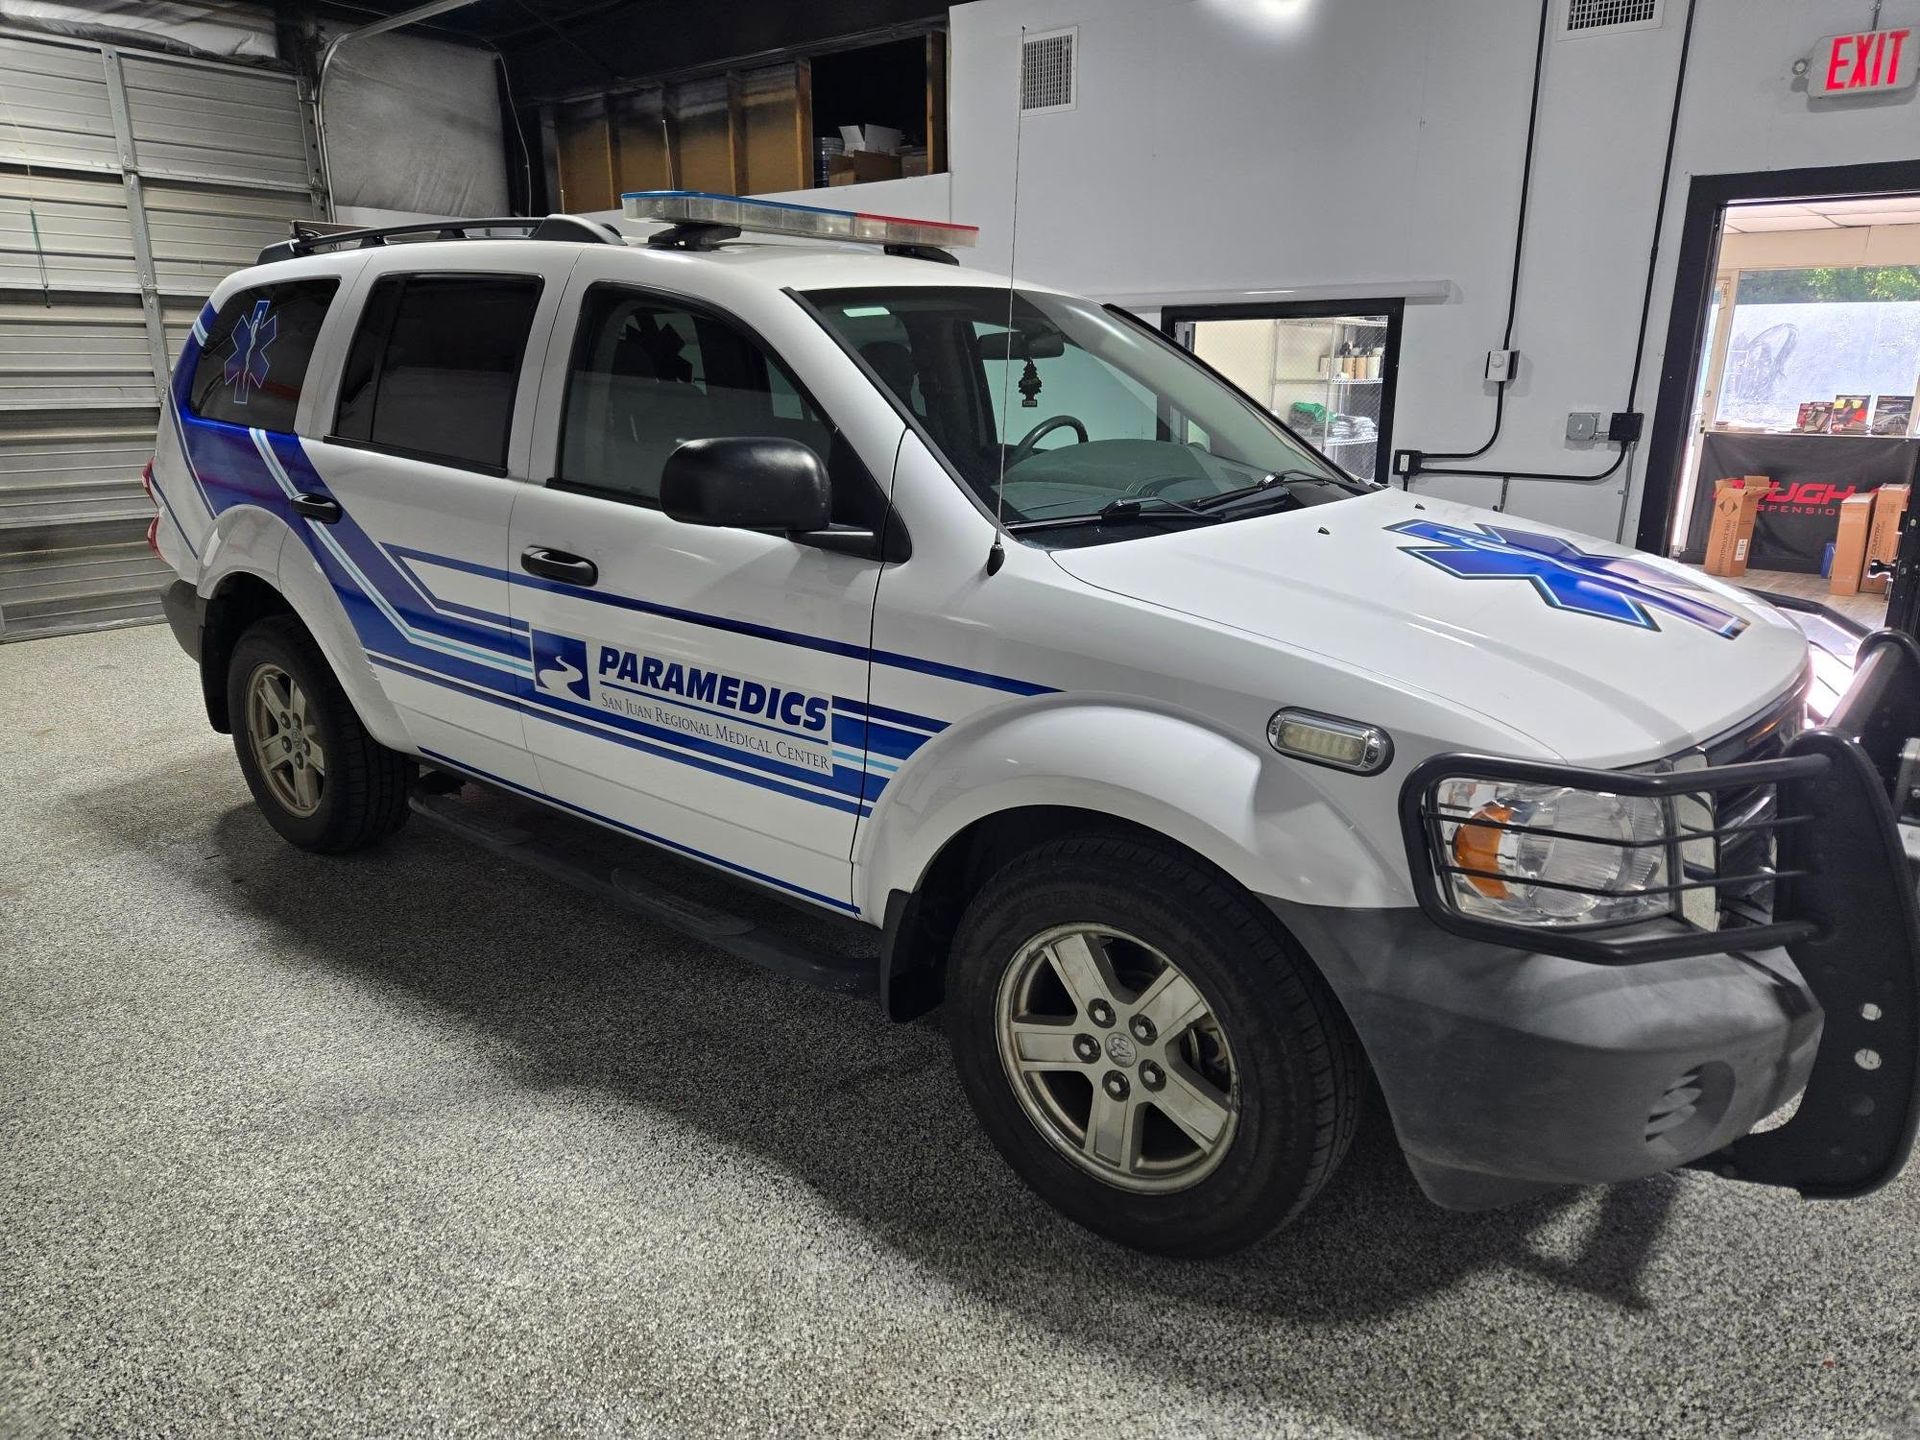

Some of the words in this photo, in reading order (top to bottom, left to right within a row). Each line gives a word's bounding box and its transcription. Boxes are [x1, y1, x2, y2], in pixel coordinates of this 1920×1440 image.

[1825, 28, 1911, 91] EXIT
[1712, 479, 1856, 504] UGH
[1756, 504, 1836, 516] SPENSIO
[598, 645, 830, 732] PARAMEDICS
[600, 692, 623, 712] SAN
[624, 698, 652, 719] JUAN
[655, 706, 713, 737] REGIONAL
[715, 722, 773, 754] MEDICAL
[775, 740, 830, 770] CENTER
